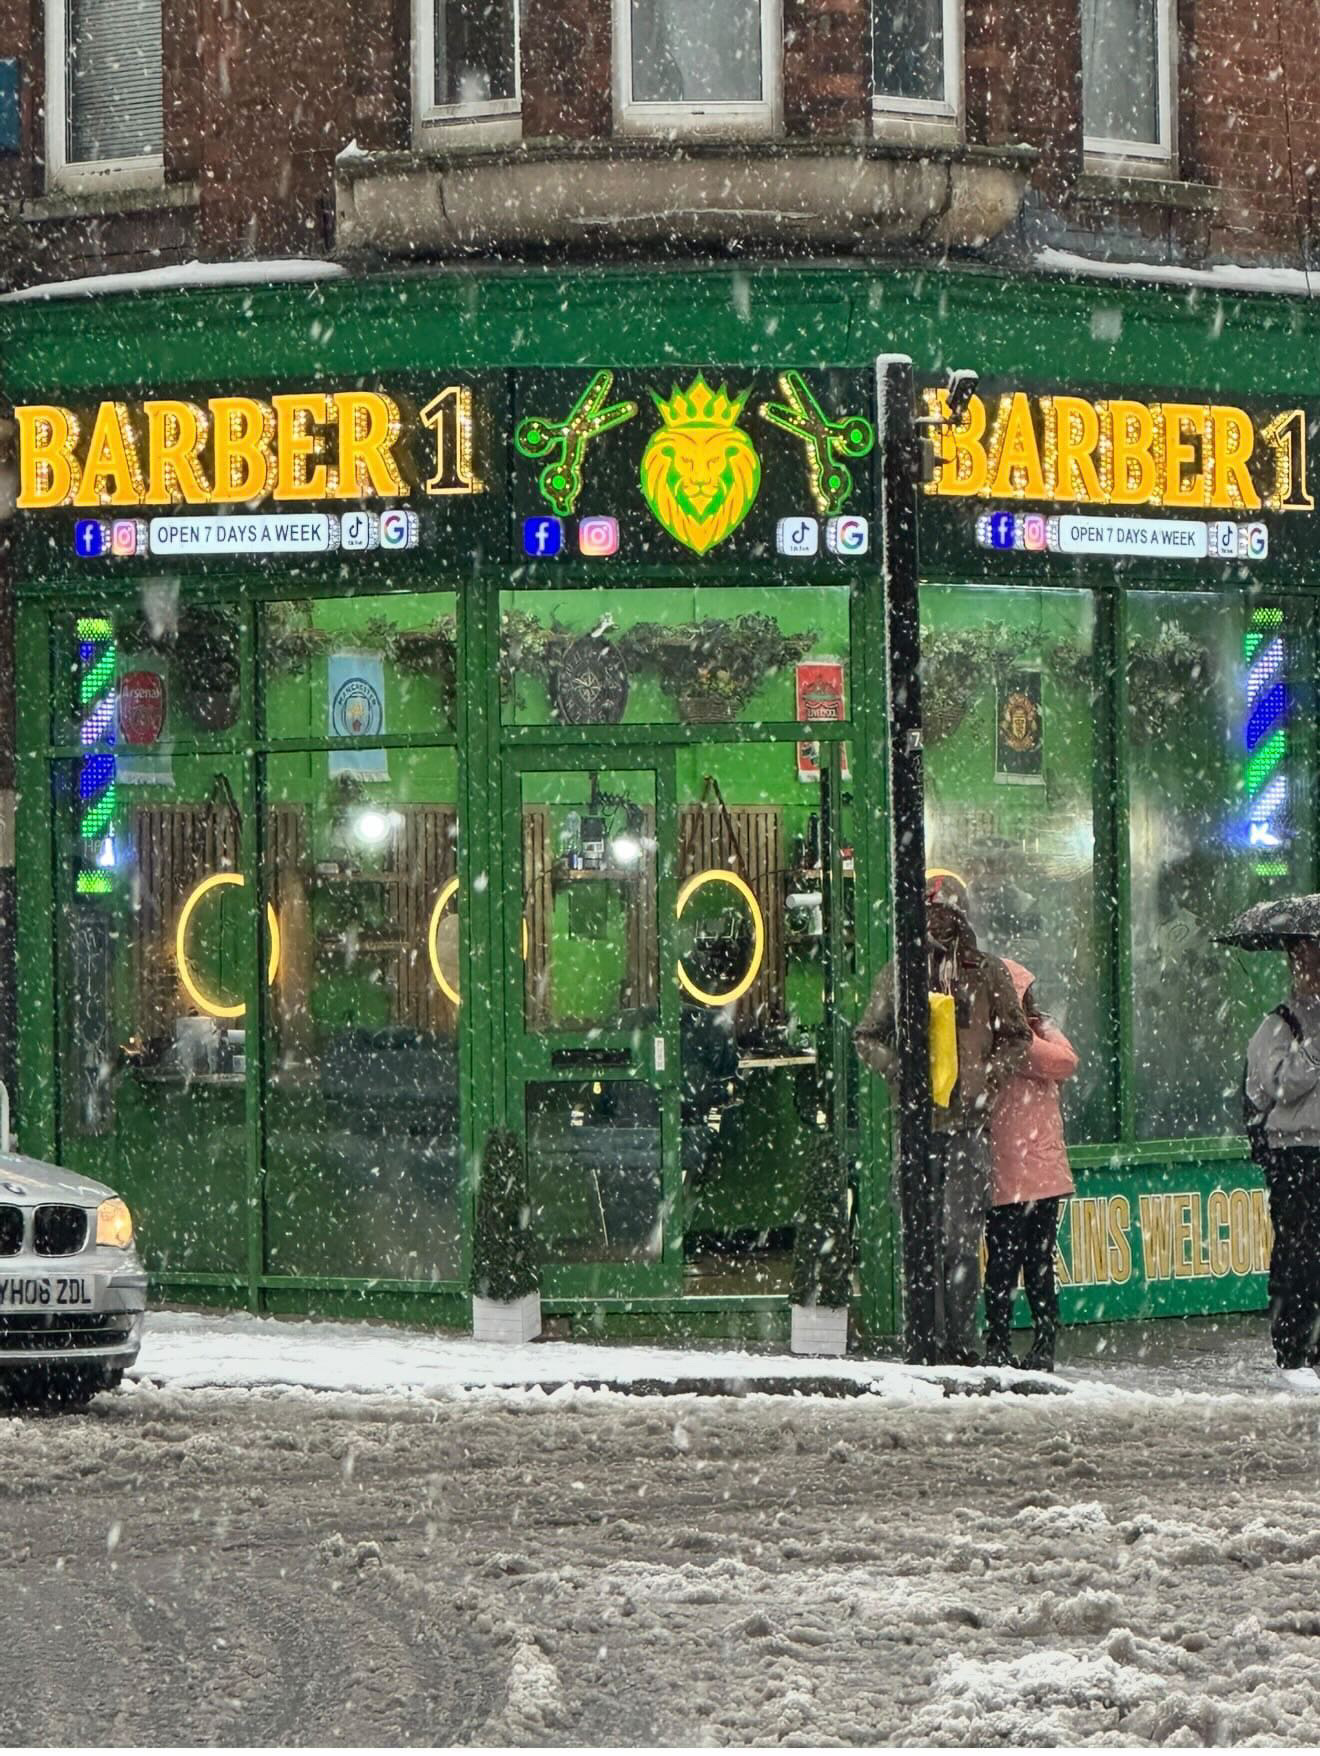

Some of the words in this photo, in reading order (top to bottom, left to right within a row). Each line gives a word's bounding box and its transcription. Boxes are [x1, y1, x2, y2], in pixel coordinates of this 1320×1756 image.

[15, 390, 410, 509] BARBER
[419, 385, 483, 495] 1
[923, 387, 1263, 510] BARBER
[1260, 409, 1314, 511] 1
[157, 526, 200, 543] OPEN
[204, 526, 213, 543] 7
[216, 525, 257, 542] DAYS
[261, 525, 271, 542] A
[275, 524, 321, 541] WEEK
[1070, 526, 1104, 542] OPEN
[1107, 527, 1114, 543] 7
[1117, 527, 1148, 544] DAYS
[1150, 530, 1159, 545] A
[1161, 530, 1196, 546] WEEK
[911, 731, 920, 747] 7
[1138, 1187, 1275, 1281] WELCOM
[56, 1278, 92, 1304] ZDL
